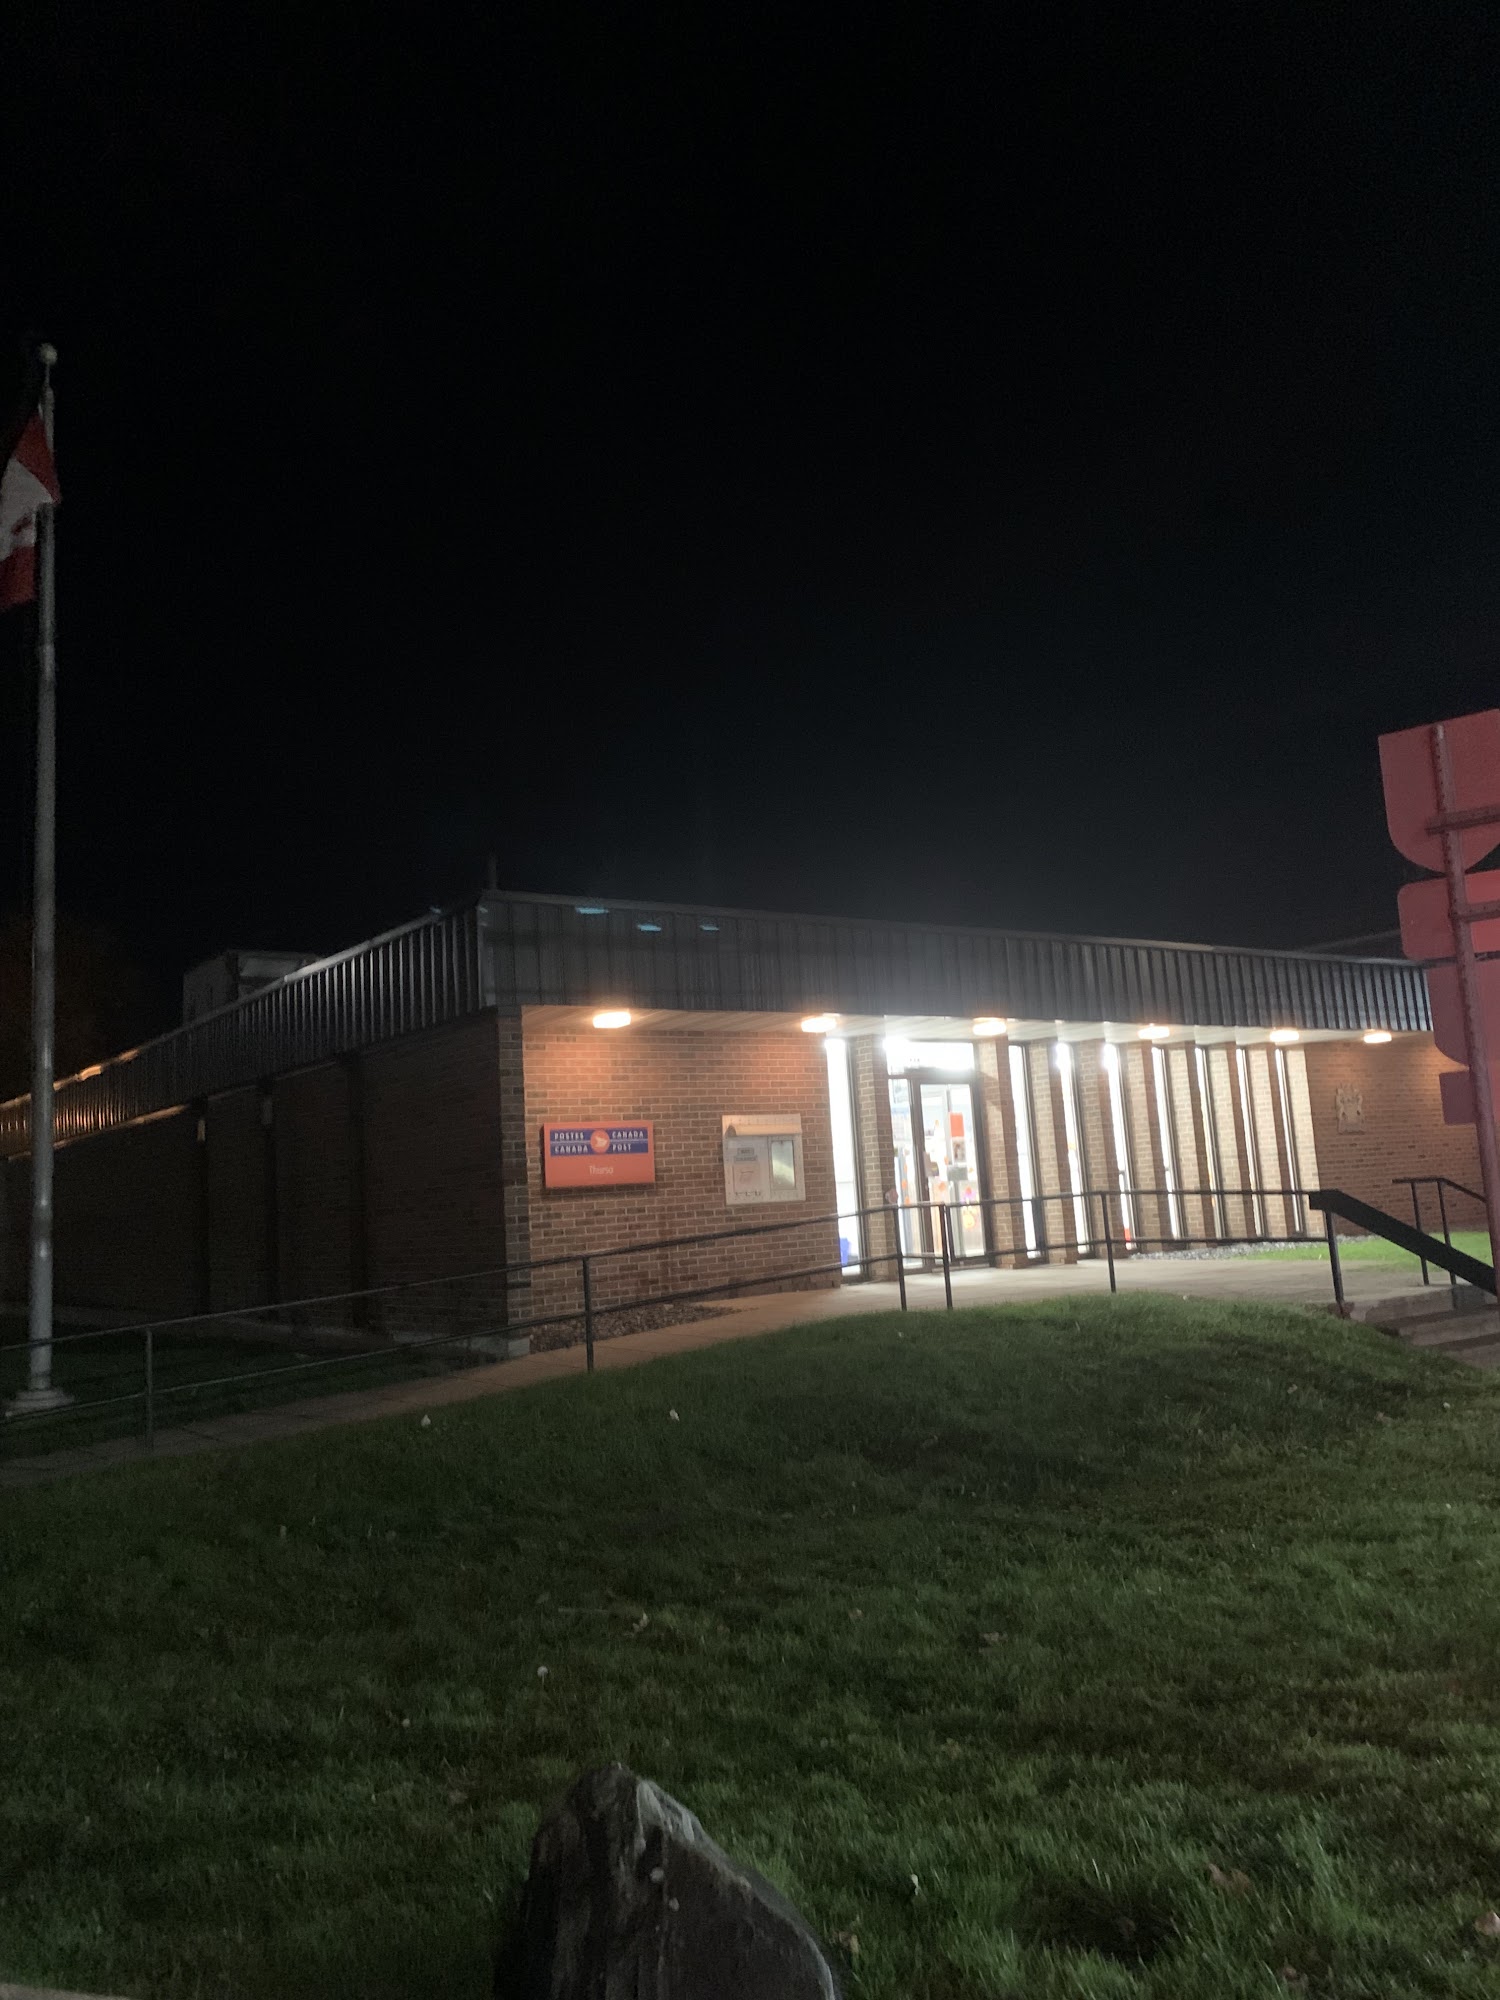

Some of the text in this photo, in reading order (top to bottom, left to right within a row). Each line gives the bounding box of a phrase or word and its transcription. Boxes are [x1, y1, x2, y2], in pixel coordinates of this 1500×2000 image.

[554, 1132, 584, 1140] POSTES
[612, 1131, 644, 1139] CANADA
[555, 1145, 588, 1153] CANADA
[612, 1143, 631, 1151] POST
